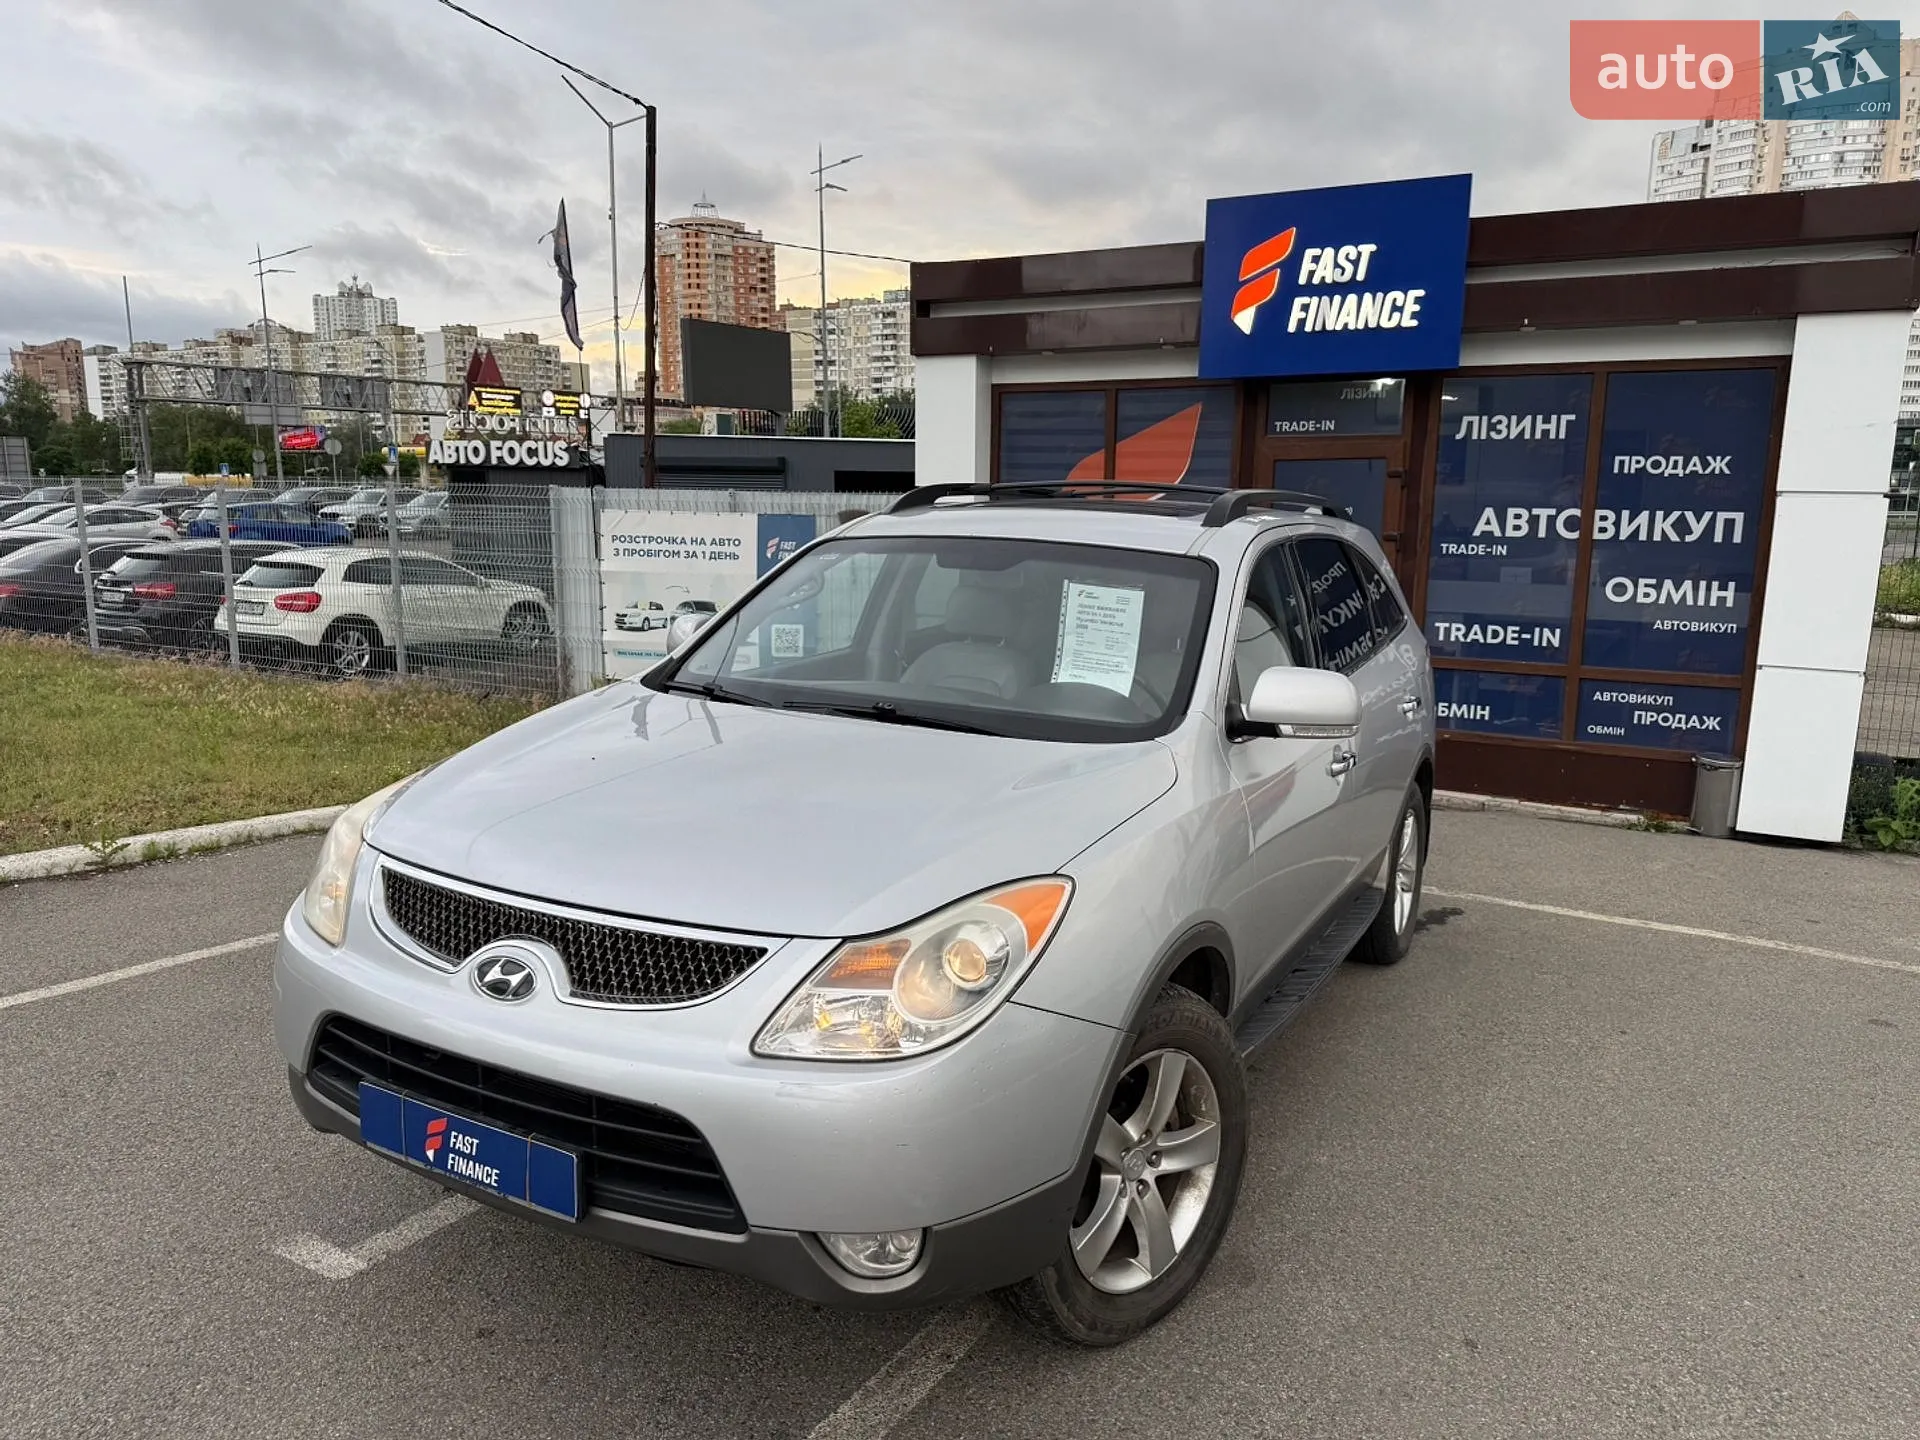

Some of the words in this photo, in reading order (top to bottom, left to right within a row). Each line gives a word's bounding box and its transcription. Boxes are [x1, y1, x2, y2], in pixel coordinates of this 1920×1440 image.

[1298, 243, 1377, 285] FAST
[1287, 289, 1426, 333] FINANCE
[1274, 420, 1335, 432] TRADE-IN
[1455, 414, 1576, 441] ЛІЗИНГ
[490, 440, 570, 467] FOCUS
[1613, 455, 1732, 477] ПРОДАЖ
[611, 534, 687, 546] РОЗСТРОЧКА
[690, 537, 707, 546] НА
[709, 537, 742, 547] АВТО
[1440, 543, 1507, 556] TRADE-IN
[622, 548, 681, 559] ПРОБІГОМ
[683, 550, 699, 560] ЗА
[701, 550, 707, 560] 1
[709, 550, 740, 561] ДЕНЬ
[1605, 576, 1736, 608] ОБМІН
[1434, 622, 1561, 649] TRADE-IN
[1652, 619, 1737, 634] АВТОВИКУП
[1592, 690, 1674, 706] АВТОВИКУП
[1437, 702, 1490, 720] БМІН
[1633, 710, 1721, 732] ПРОДАЖ
[1587, 724, 1625, 736] ОБМІН
[450, 1131, 480, 1156] FAST
[447, 1153, 500, 1186] FINANCE
